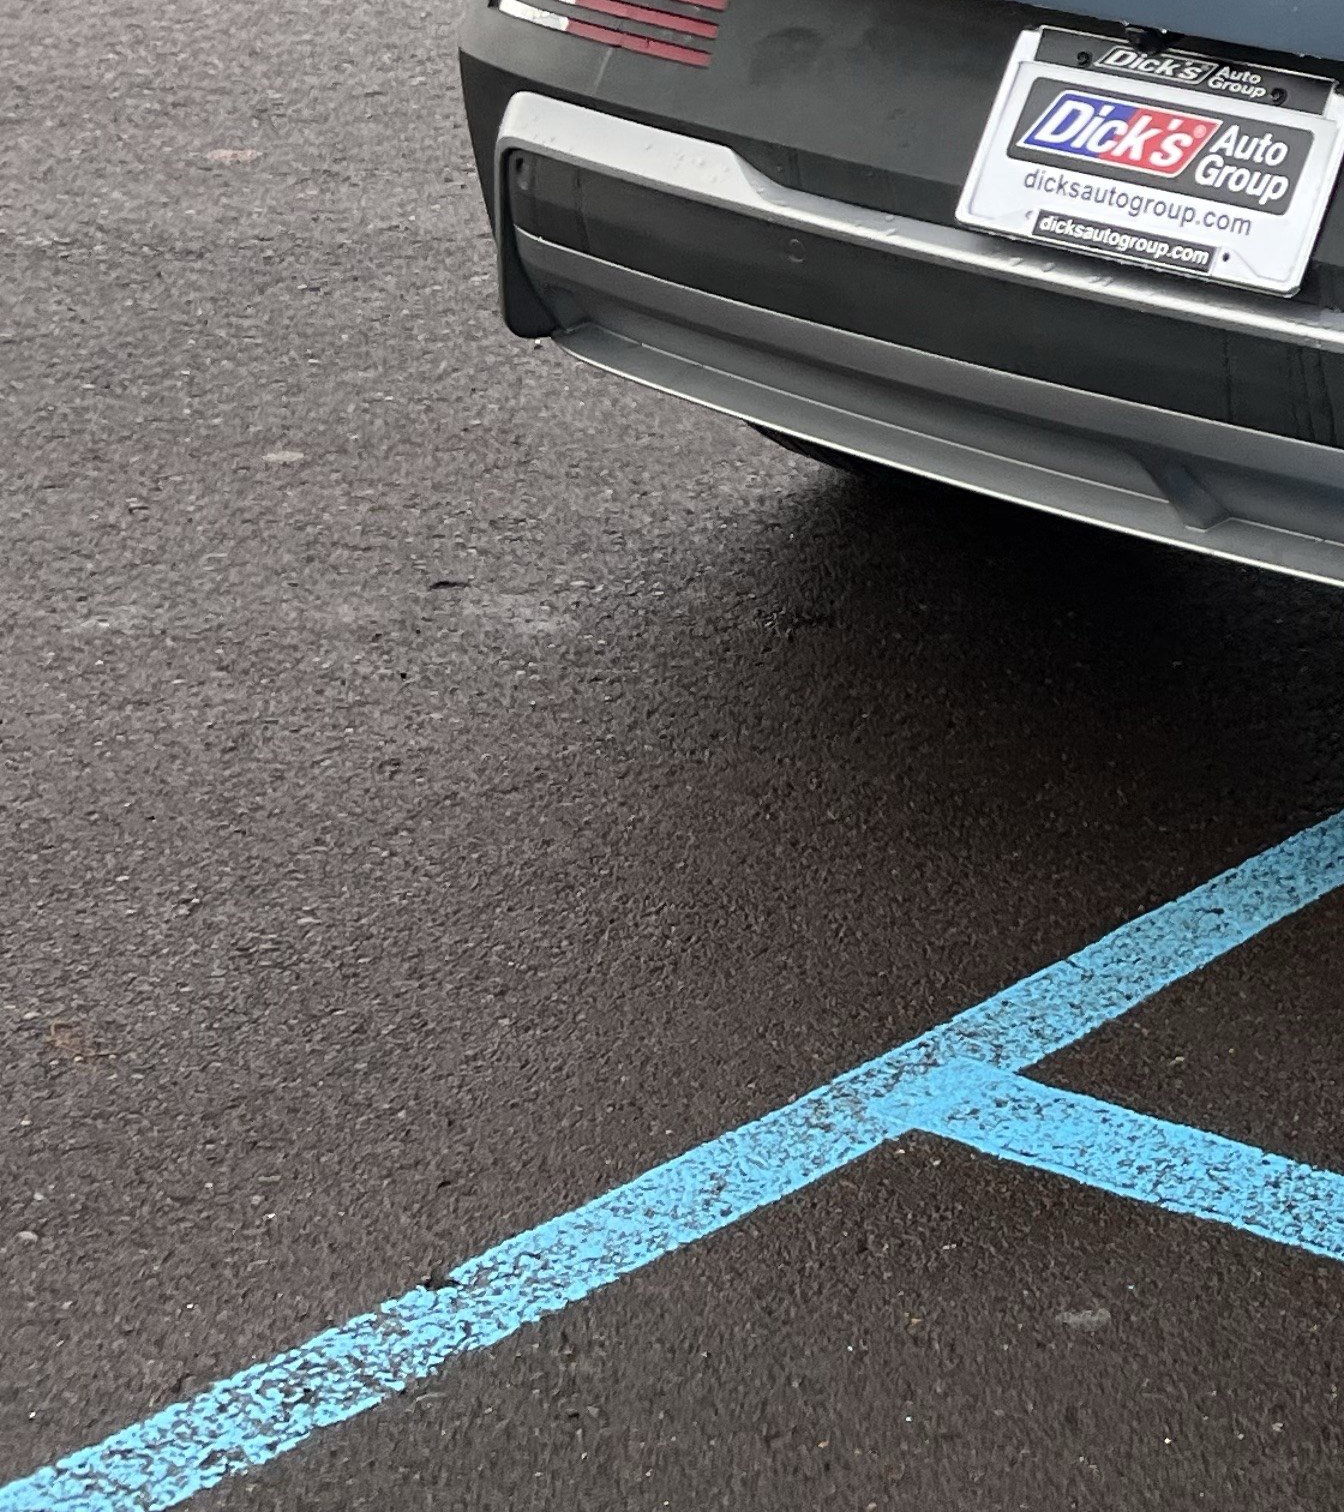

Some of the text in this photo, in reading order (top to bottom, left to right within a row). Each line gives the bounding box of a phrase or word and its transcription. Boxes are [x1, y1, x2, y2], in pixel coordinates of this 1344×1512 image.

[1105, 48, 1262, 85] Dick's Auto
[1208, 76, 1267, 100] Group
[1033, 99, 1289, 170] Dick's Auto
[1023, 168, 1252, 236] dicksautogroup.com
[1194, 158, 1290, 205] Group
[1038, 214, 1210, 267] dicksautogroup.com
